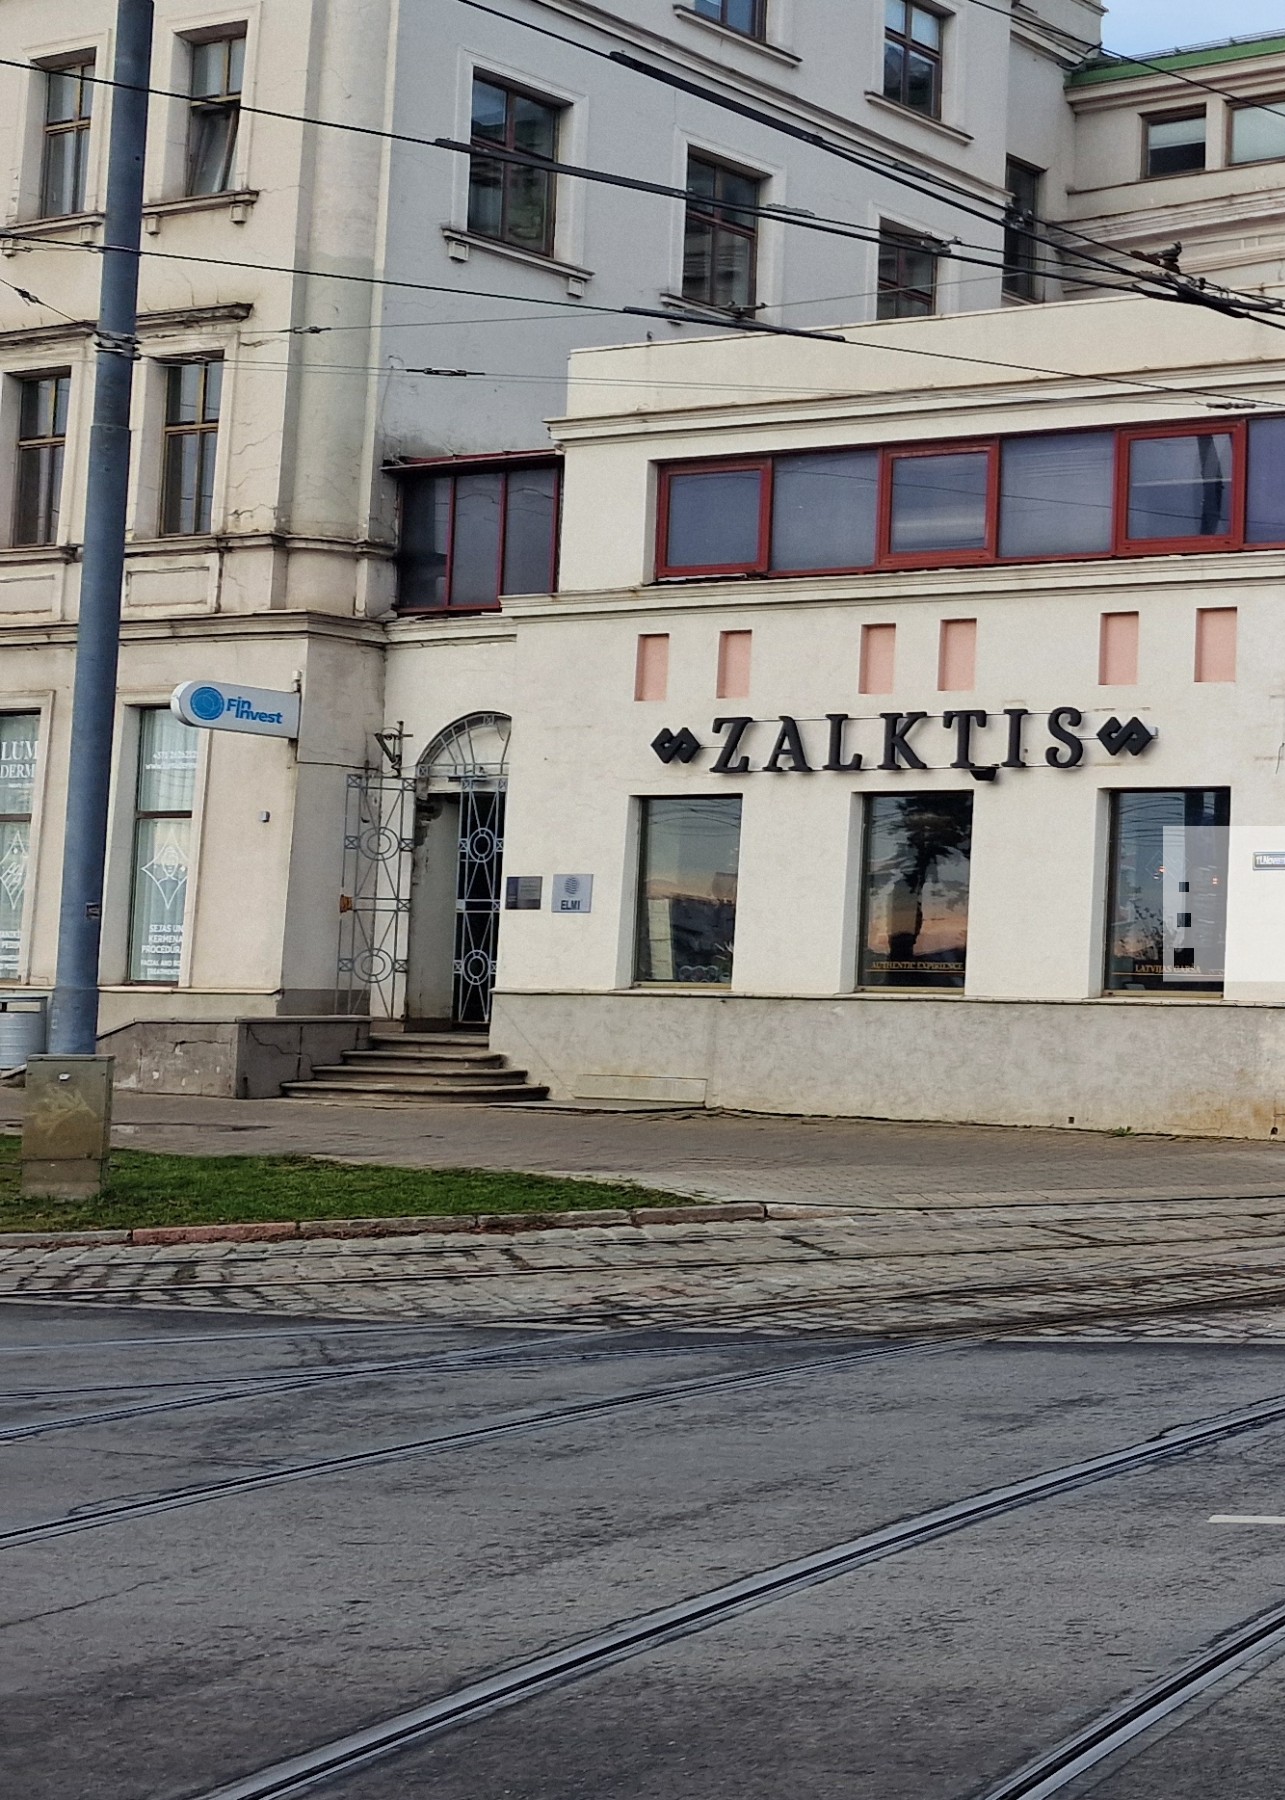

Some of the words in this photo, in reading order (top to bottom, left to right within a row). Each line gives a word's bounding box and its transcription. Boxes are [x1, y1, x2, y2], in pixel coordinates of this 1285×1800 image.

[226, 697, 251, 712] Fin
[235, 706, 282, 725] Invest
[709, 706, 1086, 774] ZALKTIS
[561, 900, 581, 910] ELMI
[871, 961, 916, 970] AUTHENTIC
